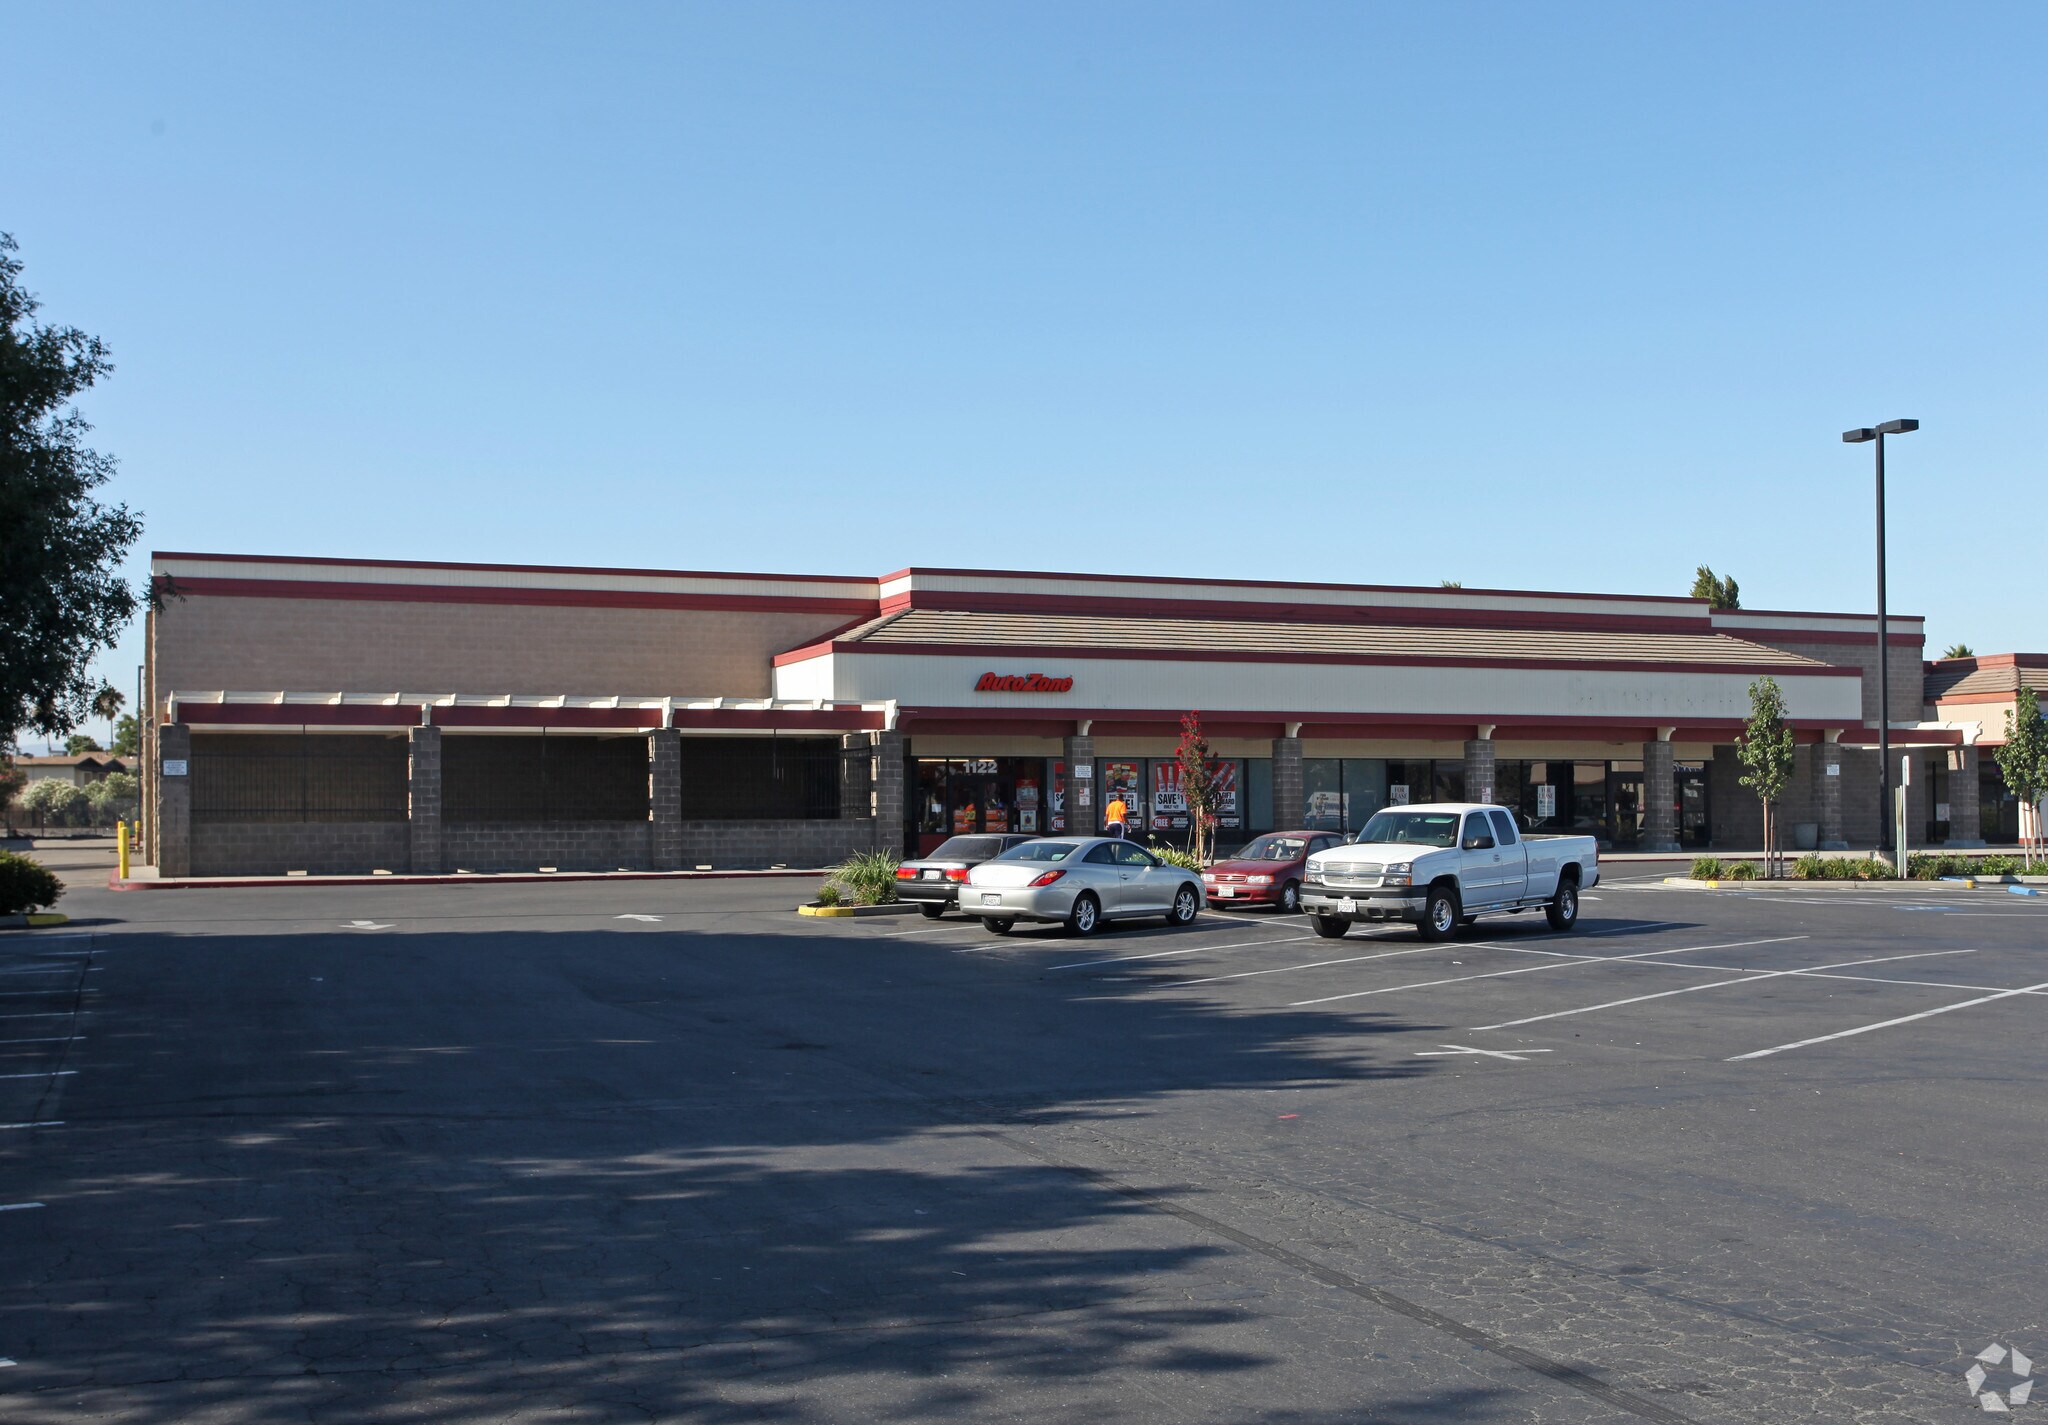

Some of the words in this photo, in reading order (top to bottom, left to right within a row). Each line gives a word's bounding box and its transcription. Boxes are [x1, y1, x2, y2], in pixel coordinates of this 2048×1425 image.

[975, 672, 1073, 692] AutoZone
[963, 761, 998, 774] 1122
[1158, 793, 1176, 805] SAVE
[1155, 818, 1169, 827] FREE
